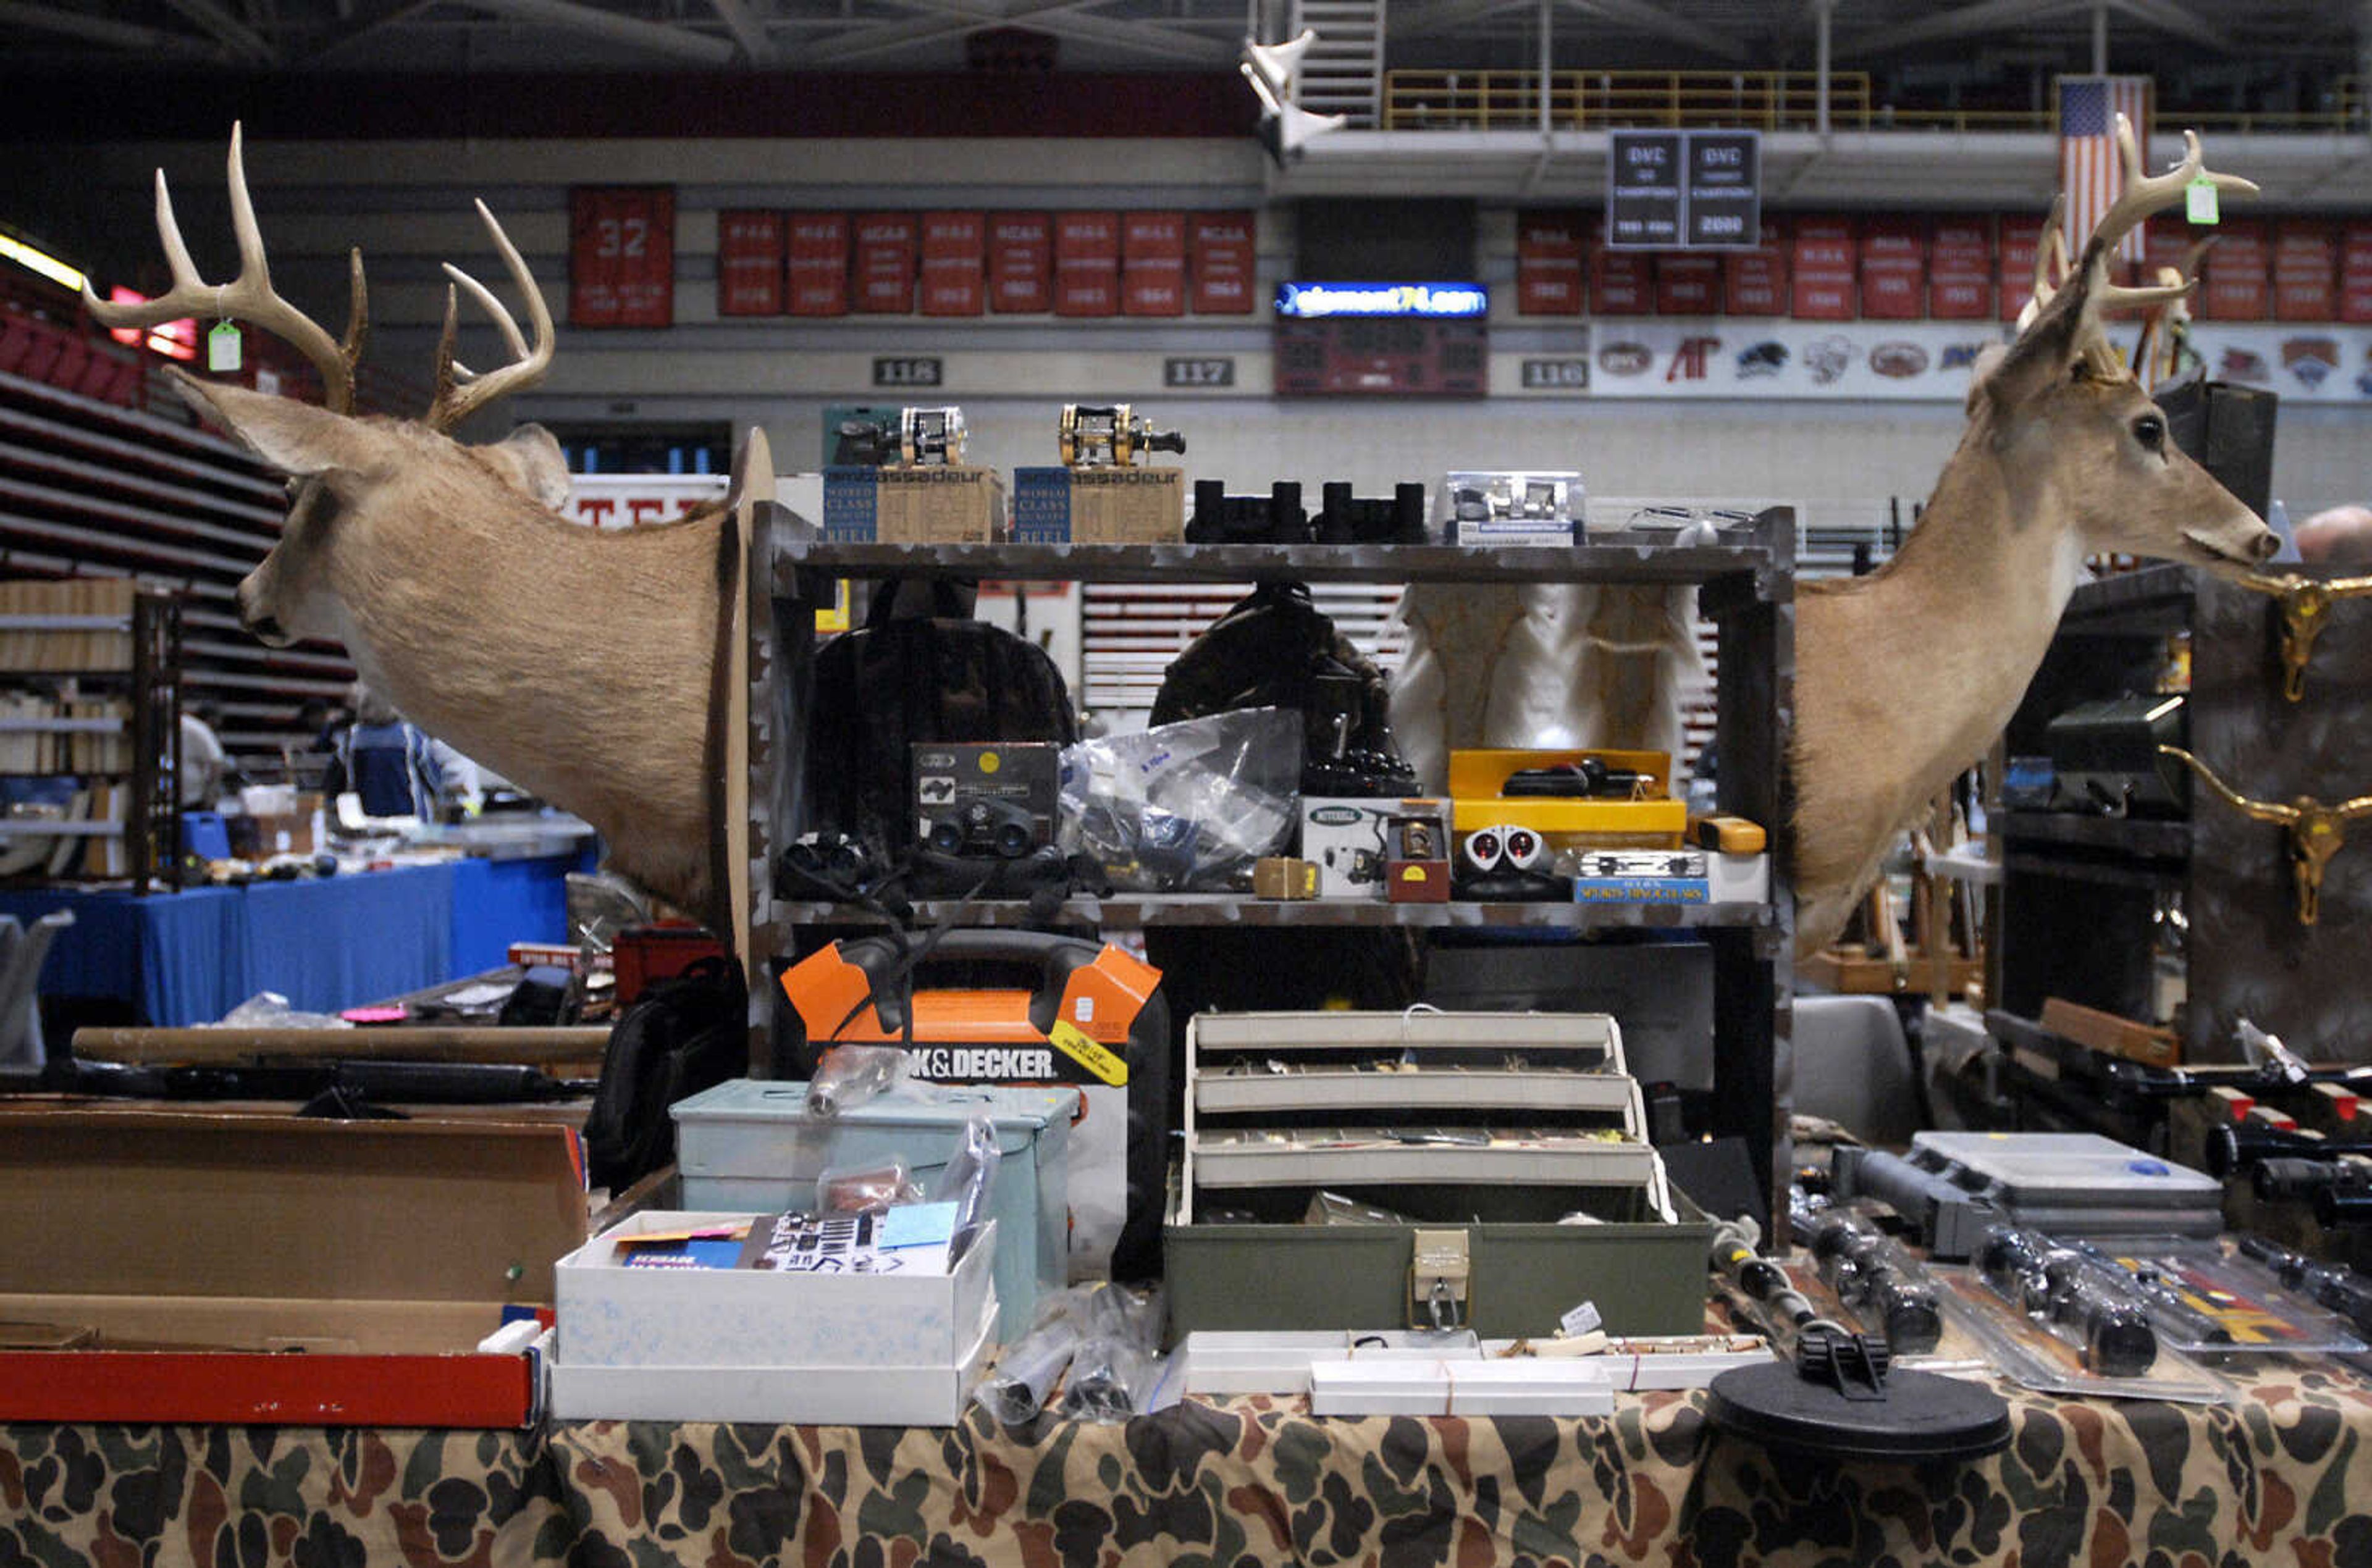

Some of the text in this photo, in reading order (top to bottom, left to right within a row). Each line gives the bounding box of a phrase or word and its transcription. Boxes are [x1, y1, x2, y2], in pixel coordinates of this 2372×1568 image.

[597, 218, 648, 258] 32
[1173, 362, 1226, 383] 117
[1019, 500, 1067, 511] CLASS
[1019, 530, 1063, 544] REEL
